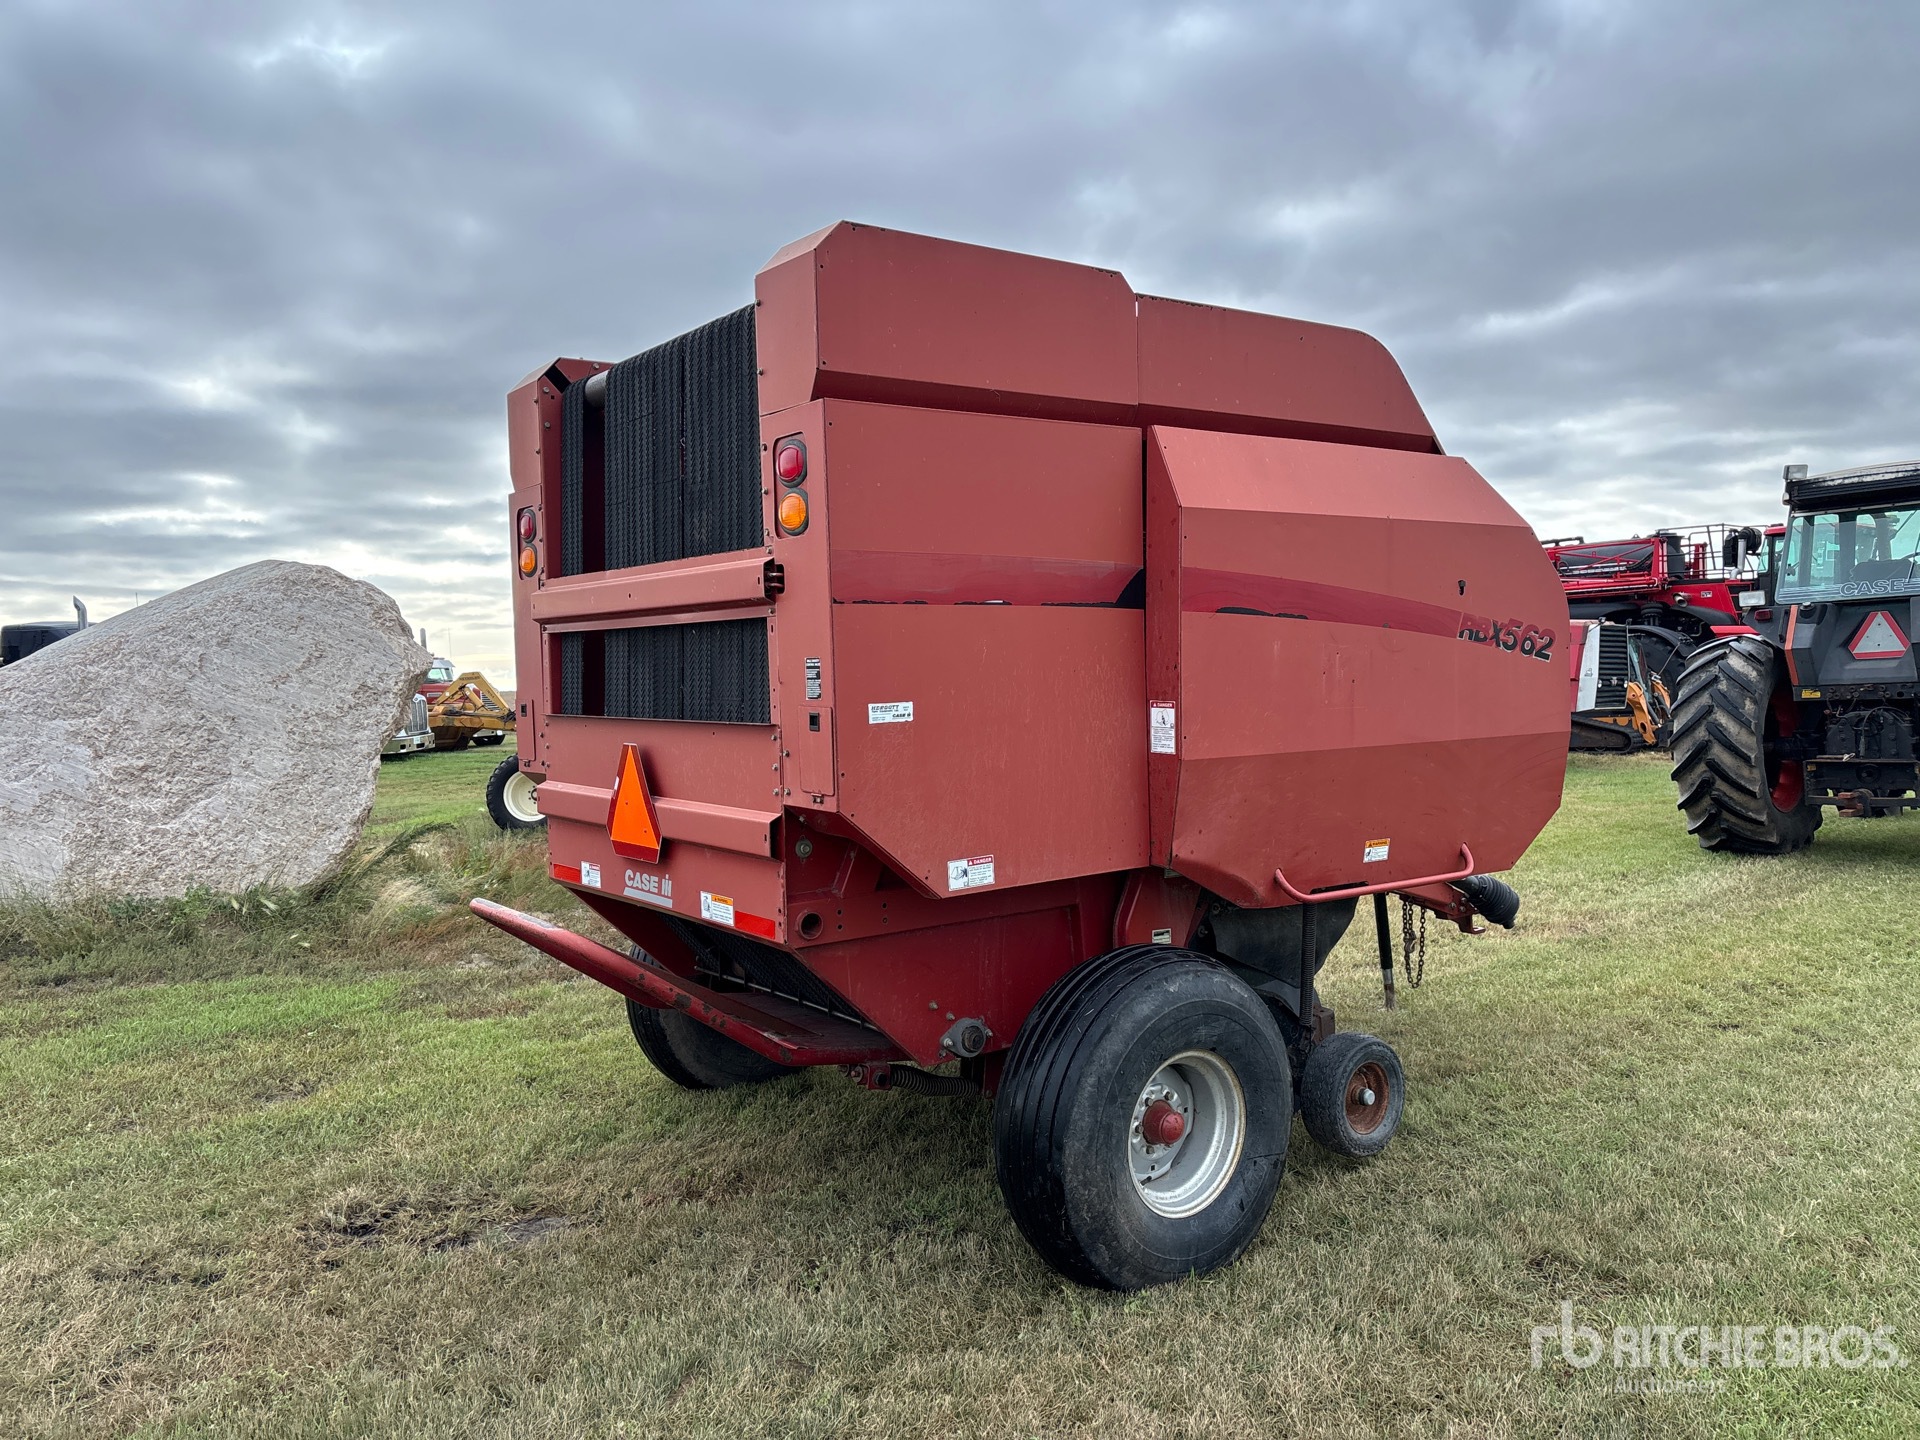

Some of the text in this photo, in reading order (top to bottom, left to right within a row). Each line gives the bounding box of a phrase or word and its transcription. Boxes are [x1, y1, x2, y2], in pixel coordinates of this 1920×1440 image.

[1840, 578, 1905, 596] CASE
[1457, 612, 1556, 662] RBX562
[625, 869, 659, 893] CASE
